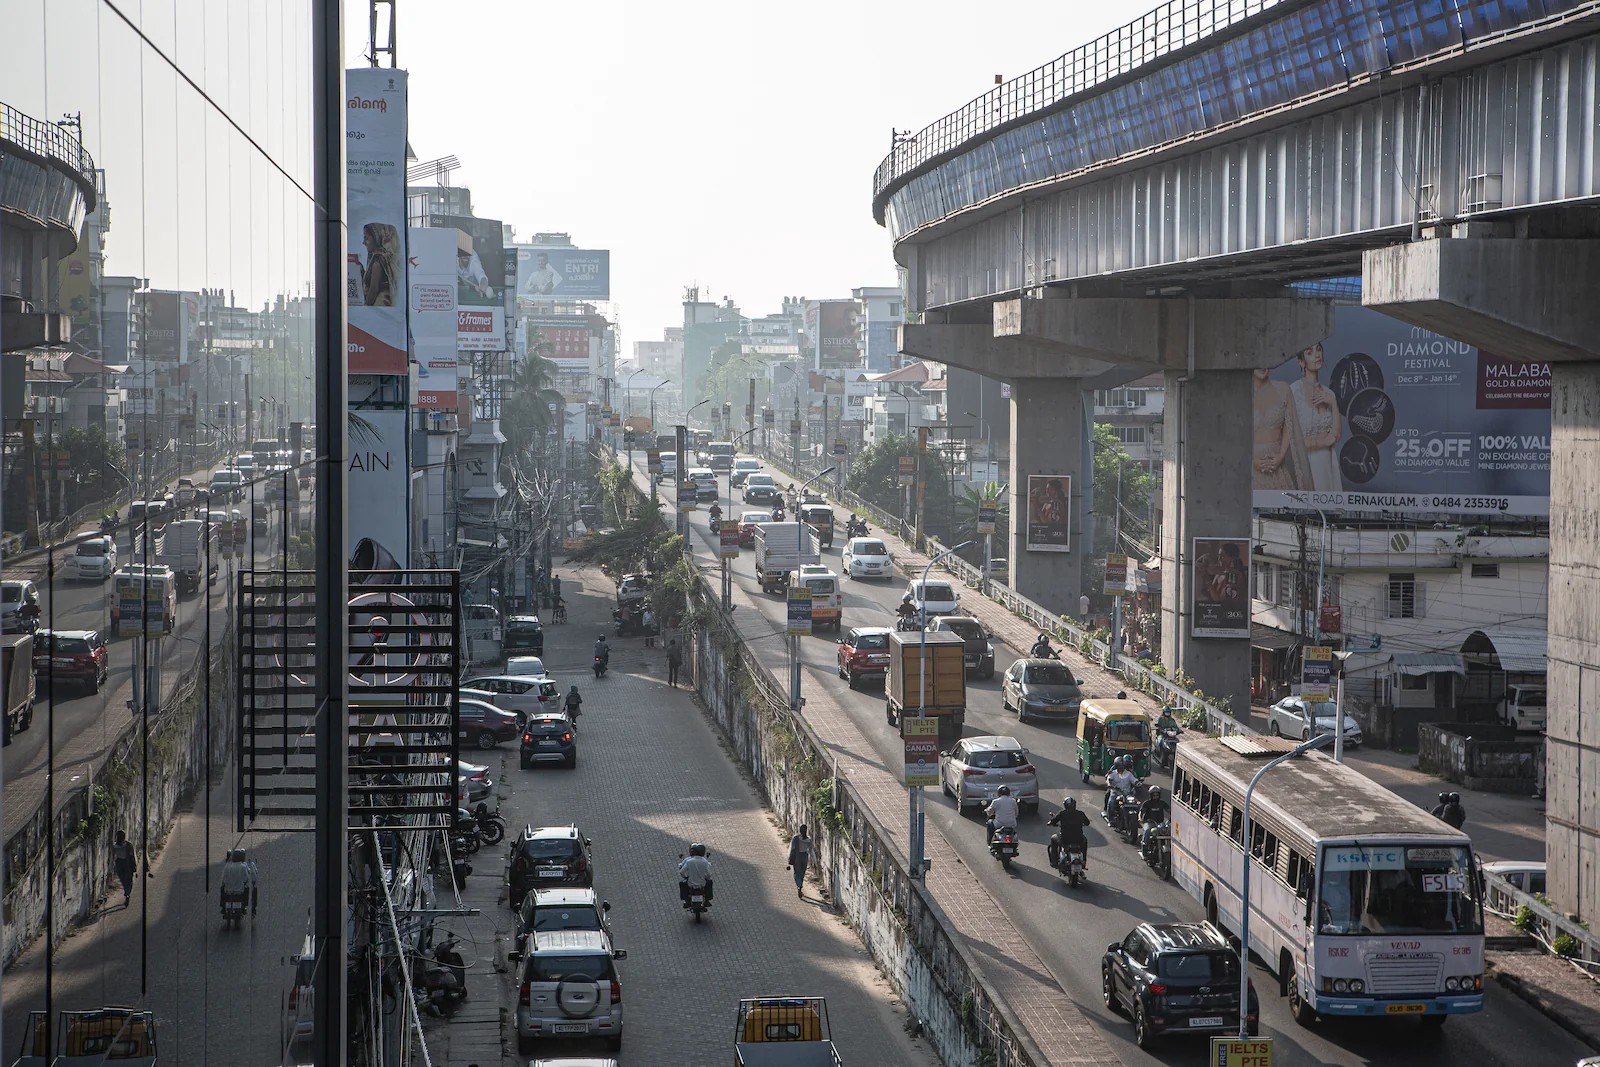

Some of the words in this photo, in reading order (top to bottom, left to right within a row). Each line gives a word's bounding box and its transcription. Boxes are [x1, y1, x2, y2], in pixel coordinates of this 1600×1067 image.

[565, 264, 599, 273] ENTRI
[1387, 341, 1470, 356] DIAMOND
[1404, 358, 1451, 368] FESTIVAL
[1486, 363, 1551, 378] MALABA
[1398, 375, 1412, 383] Dec
[1430, 374, 1443, 382] Jan
[1486, 379, 1509, 388] GOLD
[1510, 379, 1516, 387] &
[1516, 379, 1551, 387] DIAMON
[1395, 428, 1407, 437] UP
[1407, 428, 1419, 437] TO
[1478, 435, 1518, 450] 100%
[1478, 452, 1492, 460] ON
[1492, 452, 1537, 460] EXCHANGE
[1538, 452, 1550, 460] OF
[1407, 459, 1444, 467] DIAMOND
[1445, 459, 1470, 467] VALUE
[1313, 494, 1345, 505] ROAD,
[1347, 494, 1419, 507] ERNAKULAM.
[1432, 496, 1461, 508] 0484
[1464, 498, 1509, 510] 2353916
[905, 744, 937, 752] CANADA
[1337, 853, 1398, 863] KSRTC
[1423, 874, 1466, 893] FSLS
[1391, 942, 1421, 950] VENAD
[1230, 1043, 1268, 1054] IELTS
[1219, 1045, 1227, 1066] FREE
[1241, 1056, 1268, 1067] PTE
